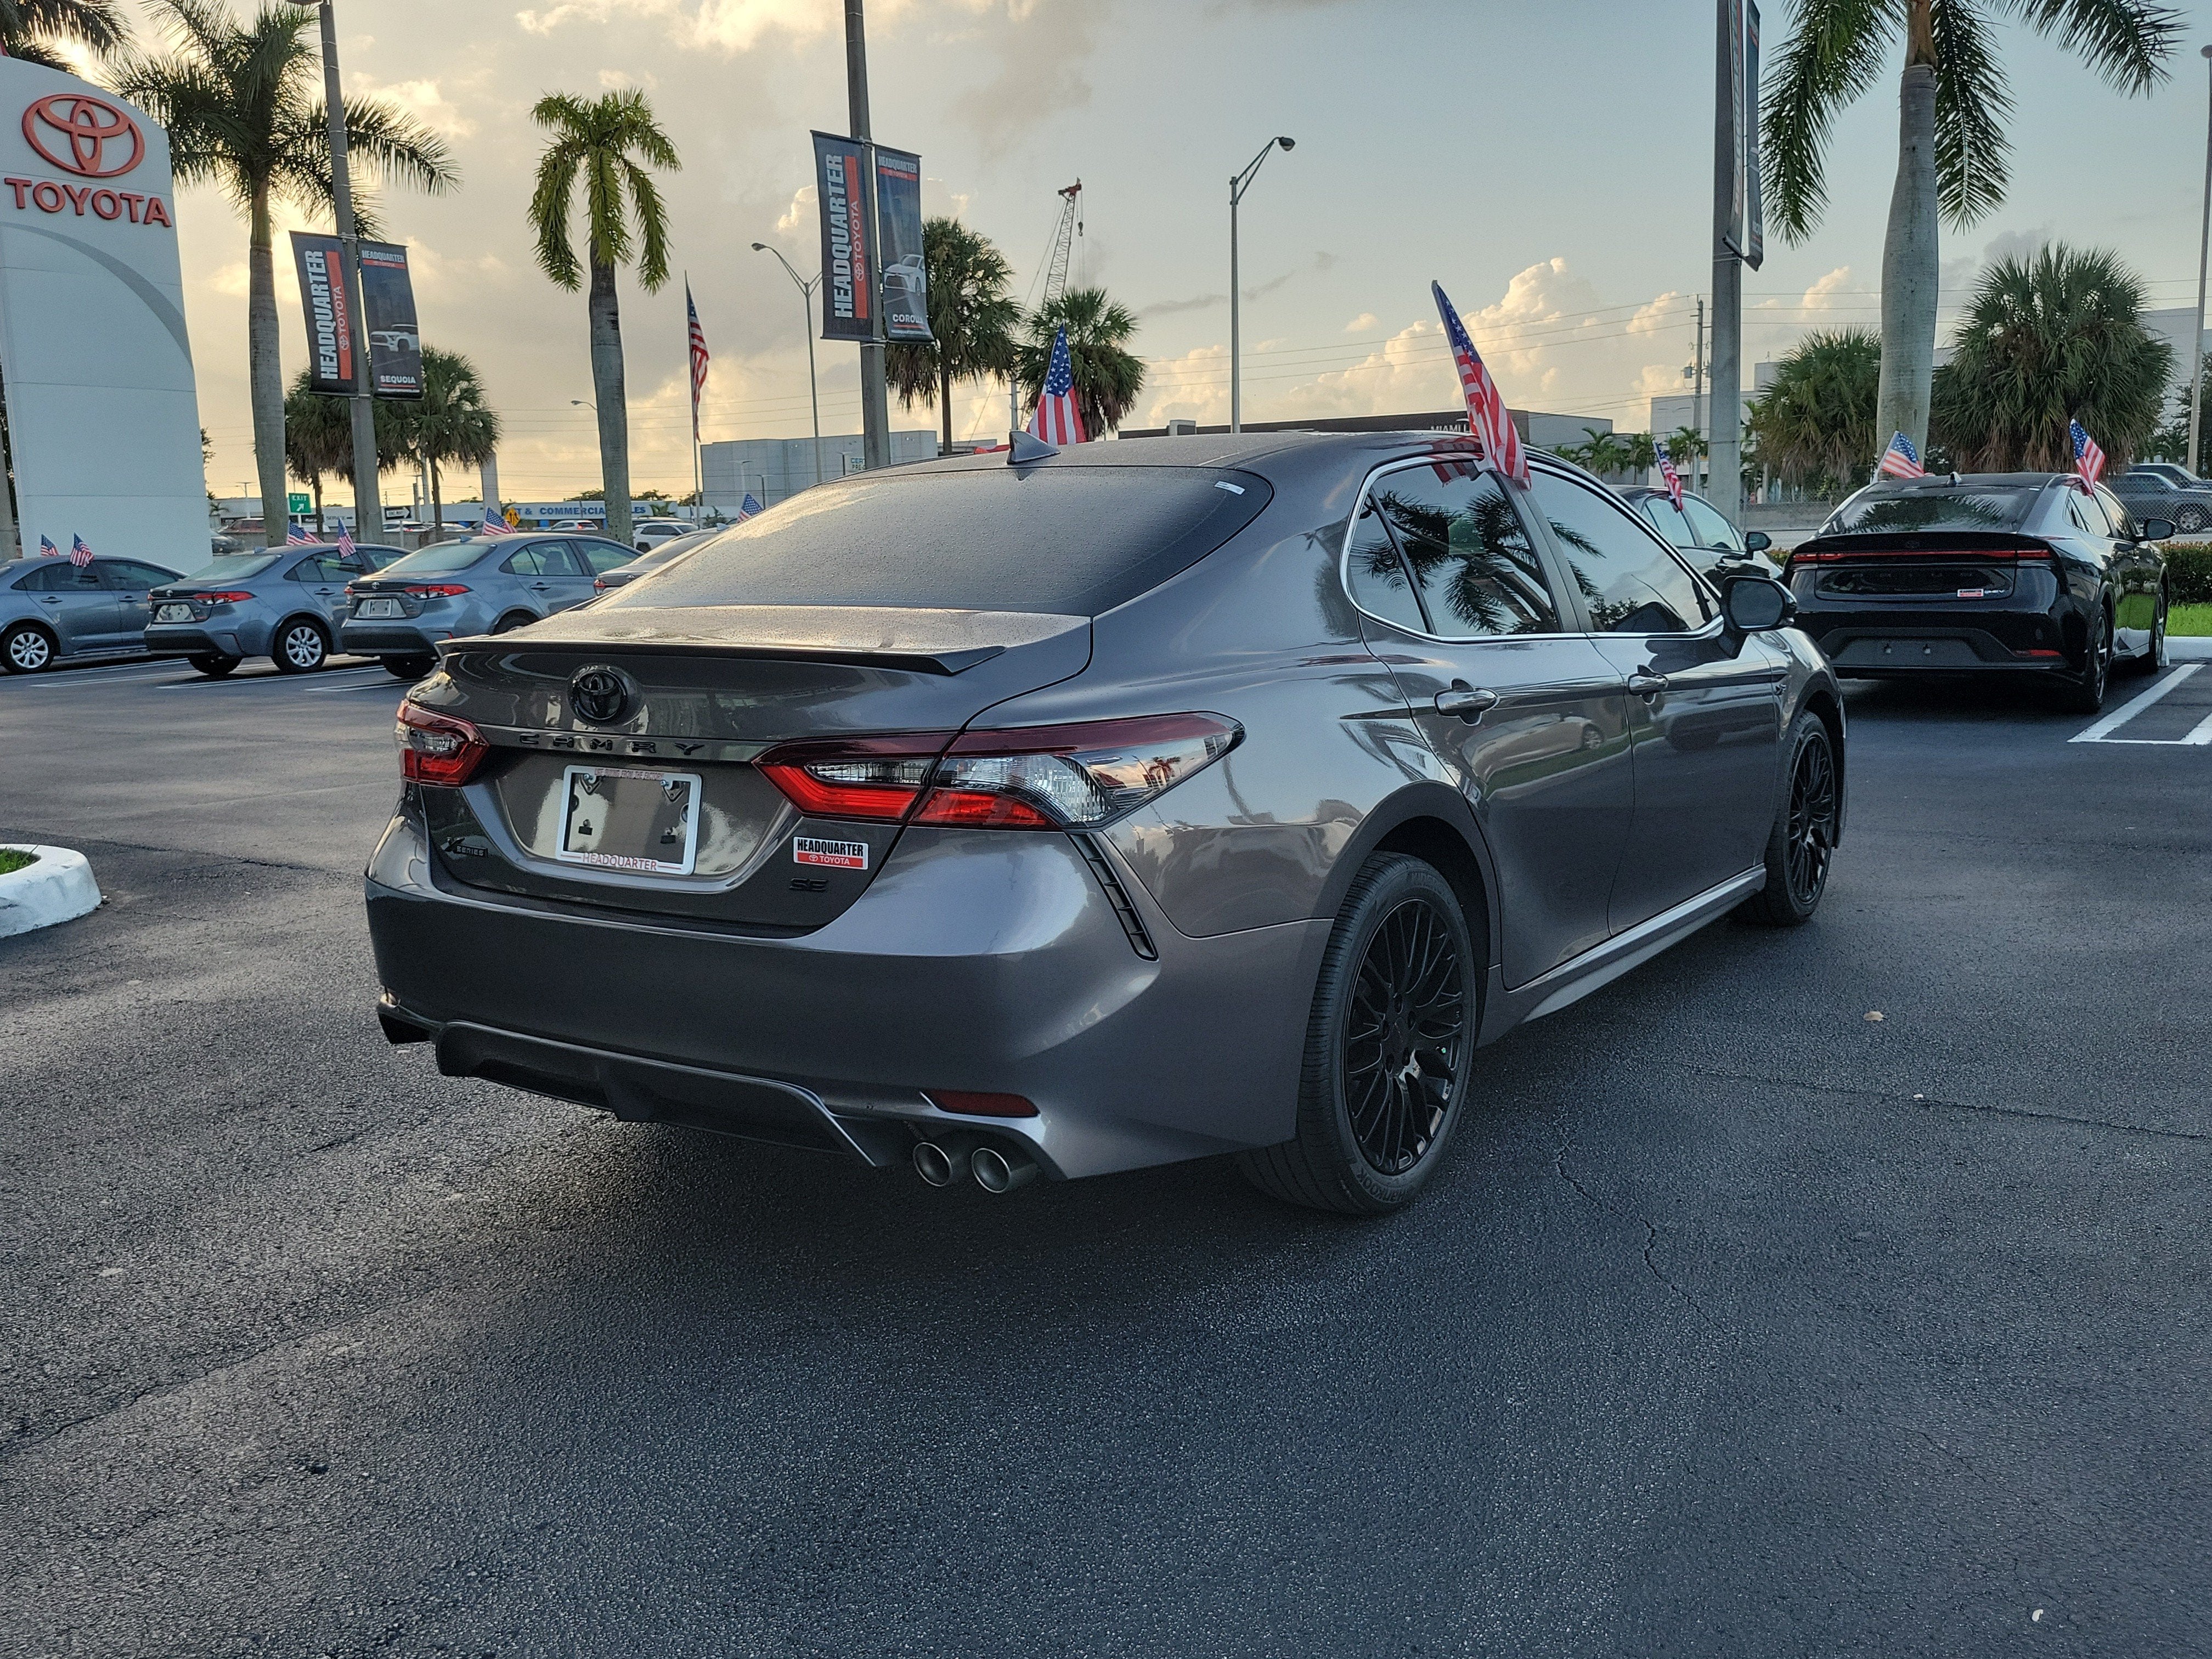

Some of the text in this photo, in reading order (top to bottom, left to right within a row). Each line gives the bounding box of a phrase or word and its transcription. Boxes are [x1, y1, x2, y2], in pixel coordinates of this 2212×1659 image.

[878, 156, 917, 174] HEADQUARTER
[4, 177, 172, 227] TOYOTA
[826, 154, 853, 318] HEADQUARTER
[850, 200, 864, 262] TOYOTA
[362, 250, 405, 263] HEADQUARTER
[305, 250, 338, 380] HEADQUARTER
[333, 285, 347, 333] TOYOTA
[380, 375, 416, 383] SEQUOIA
[540, 507, 605, 516] COMMERCIA
[520, 733, 705, 755] CAMRY
[456, 845, 484, 856] SERIES
[798, 839, 864, 857] HEADQUARTER
[583, 853, 657, 871] HEADQUARTER
[820, 856, 850, 865] TOYOTA
[789, 878, 828, 891] SE
